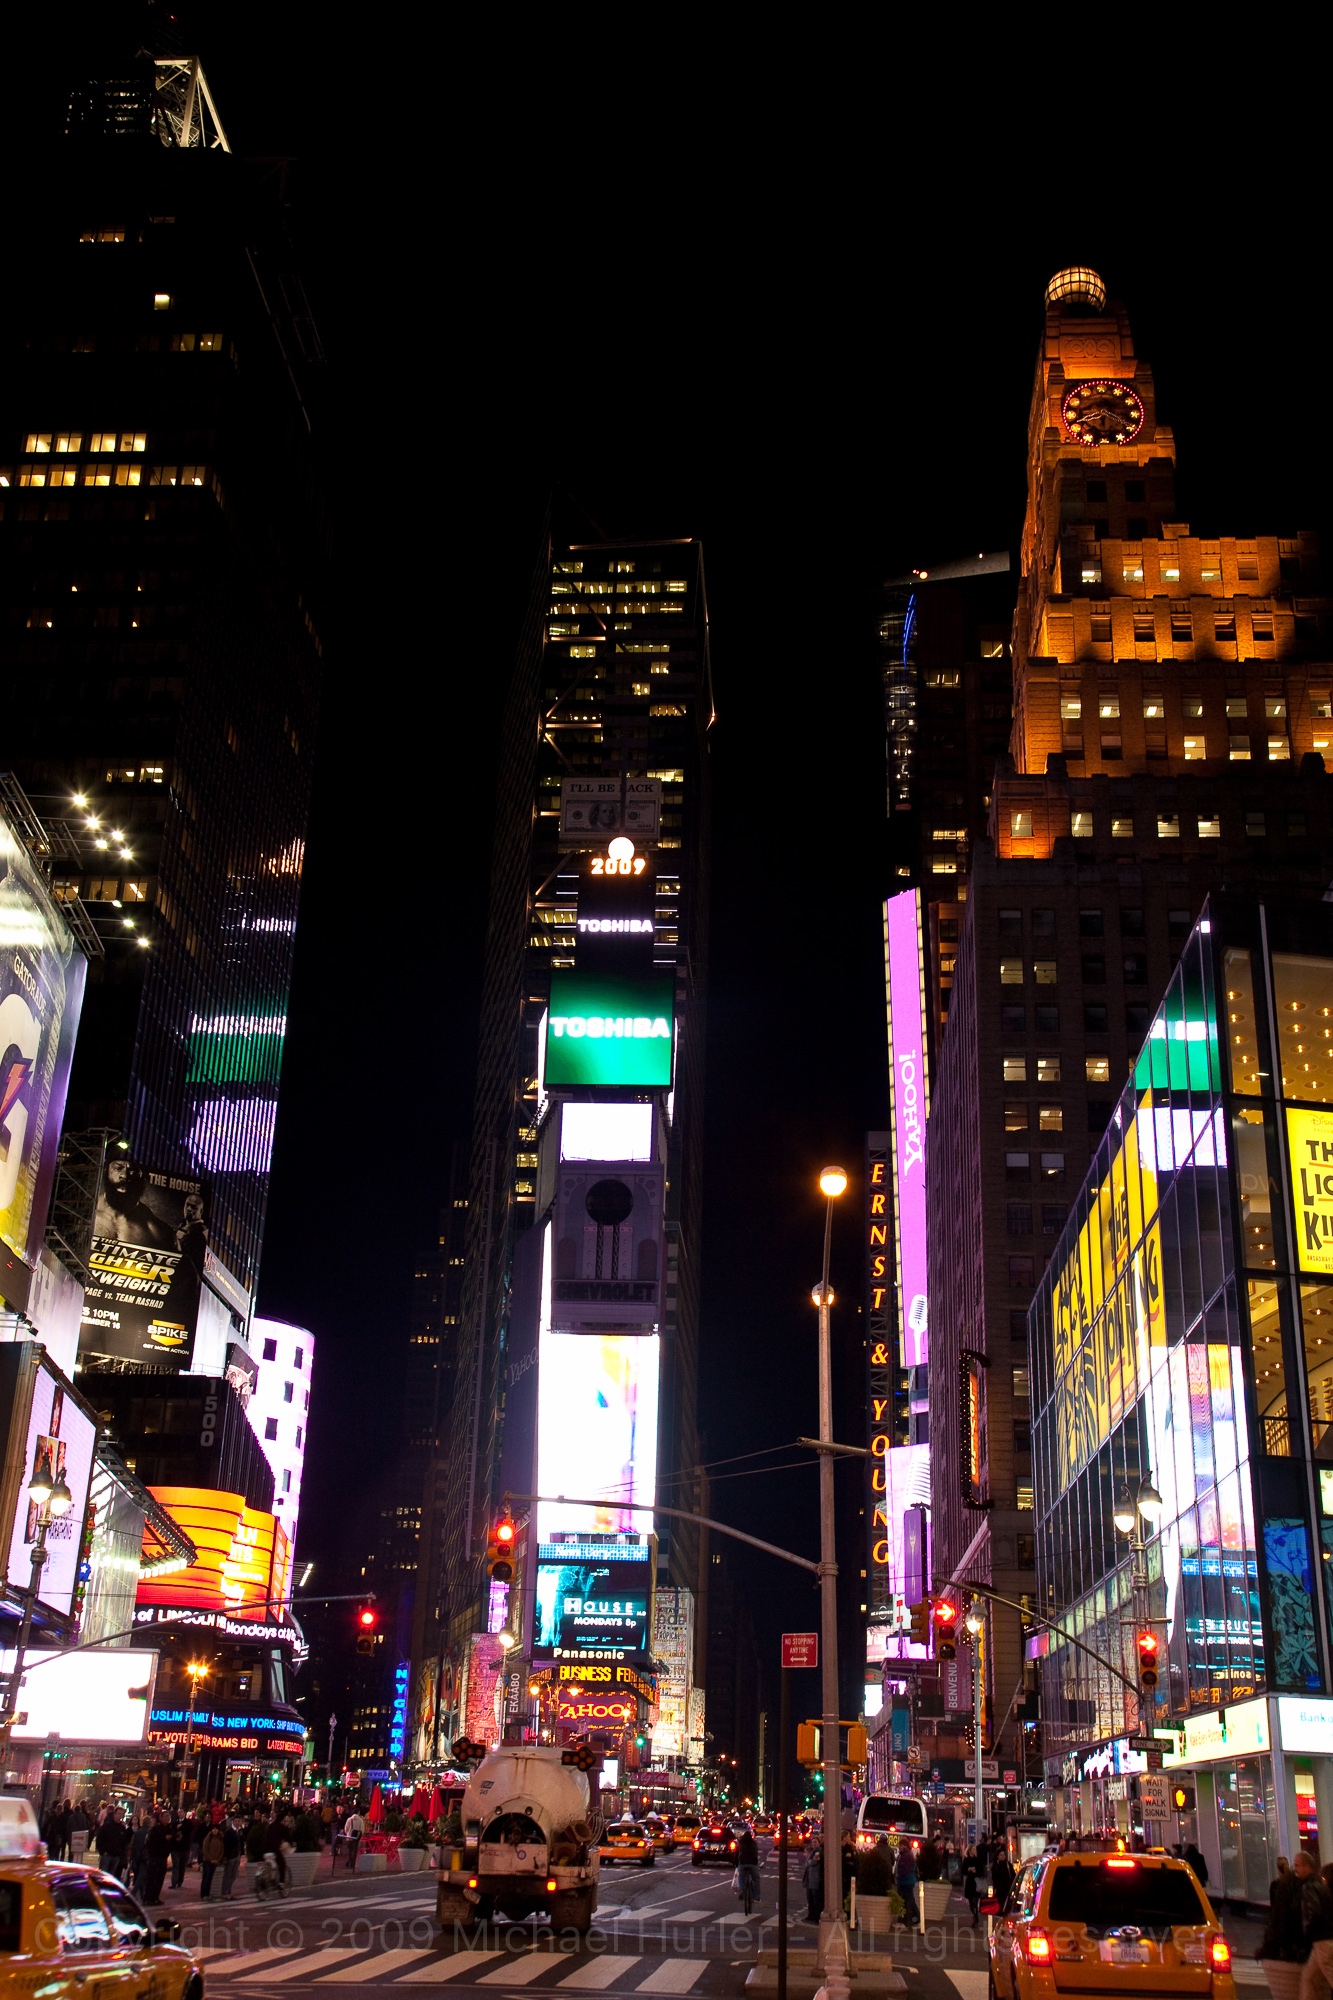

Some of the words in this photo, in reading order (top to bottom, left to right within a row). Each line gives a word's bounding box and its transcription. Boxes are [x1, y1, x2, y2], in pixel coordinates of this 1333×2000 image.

[570, 784, 594, 793] I'LL
[597, 784, 615, 793] BE
[619, 784, 654, 793] ACK
[591, 858, 646, 875] 2009
[578, 919, 654, 933] TOSHIBA
[14, 954, 47, 1016] GATORADE
[550, 1016, 670, 1038] TOSHIBA
[898, 1049, 924, 1177] YAHOO!
[149, 1172, 168, 1188] THE
[169, 1178, 201, 1196] HOUSE
[871, 1163, 888, 1309] ERNST
[556, 1282, 656, 1301] CHEVROLET
[115, 1292, 135, 1305] TEAM
[136, 1296, 164, 1310] RASHAD
[93, 1308, 120, 1322] 10PM
[112, 1321, 120, 1330] 16
[147, 1325, 188, 1340] SPIKE
[155, 1346, 170, 1354] MORE
[171, 1348, 190, 1356] ACTION
[871, 1343, 889, 1365] &
[200, 1379, 218, 1447] 1500
[137, 1609, 154, 1622] of
[226, 1622, 278, 1639] Mondays
[574, 1616, 622, 1626] MONDAYS
[554, 1648, 624, 1660] Panasonic
[227, 1718, 248, 1728] NEW
[165, 1732, 188, 1743] VOTE
[240, 1739, 258, 1748] BID
[1146, 1779, 1162, 1787] WAIT
[1146, 1798, 1166, 1807] WALK
[1144, 1810, 1168, 1818] SIGNAL
